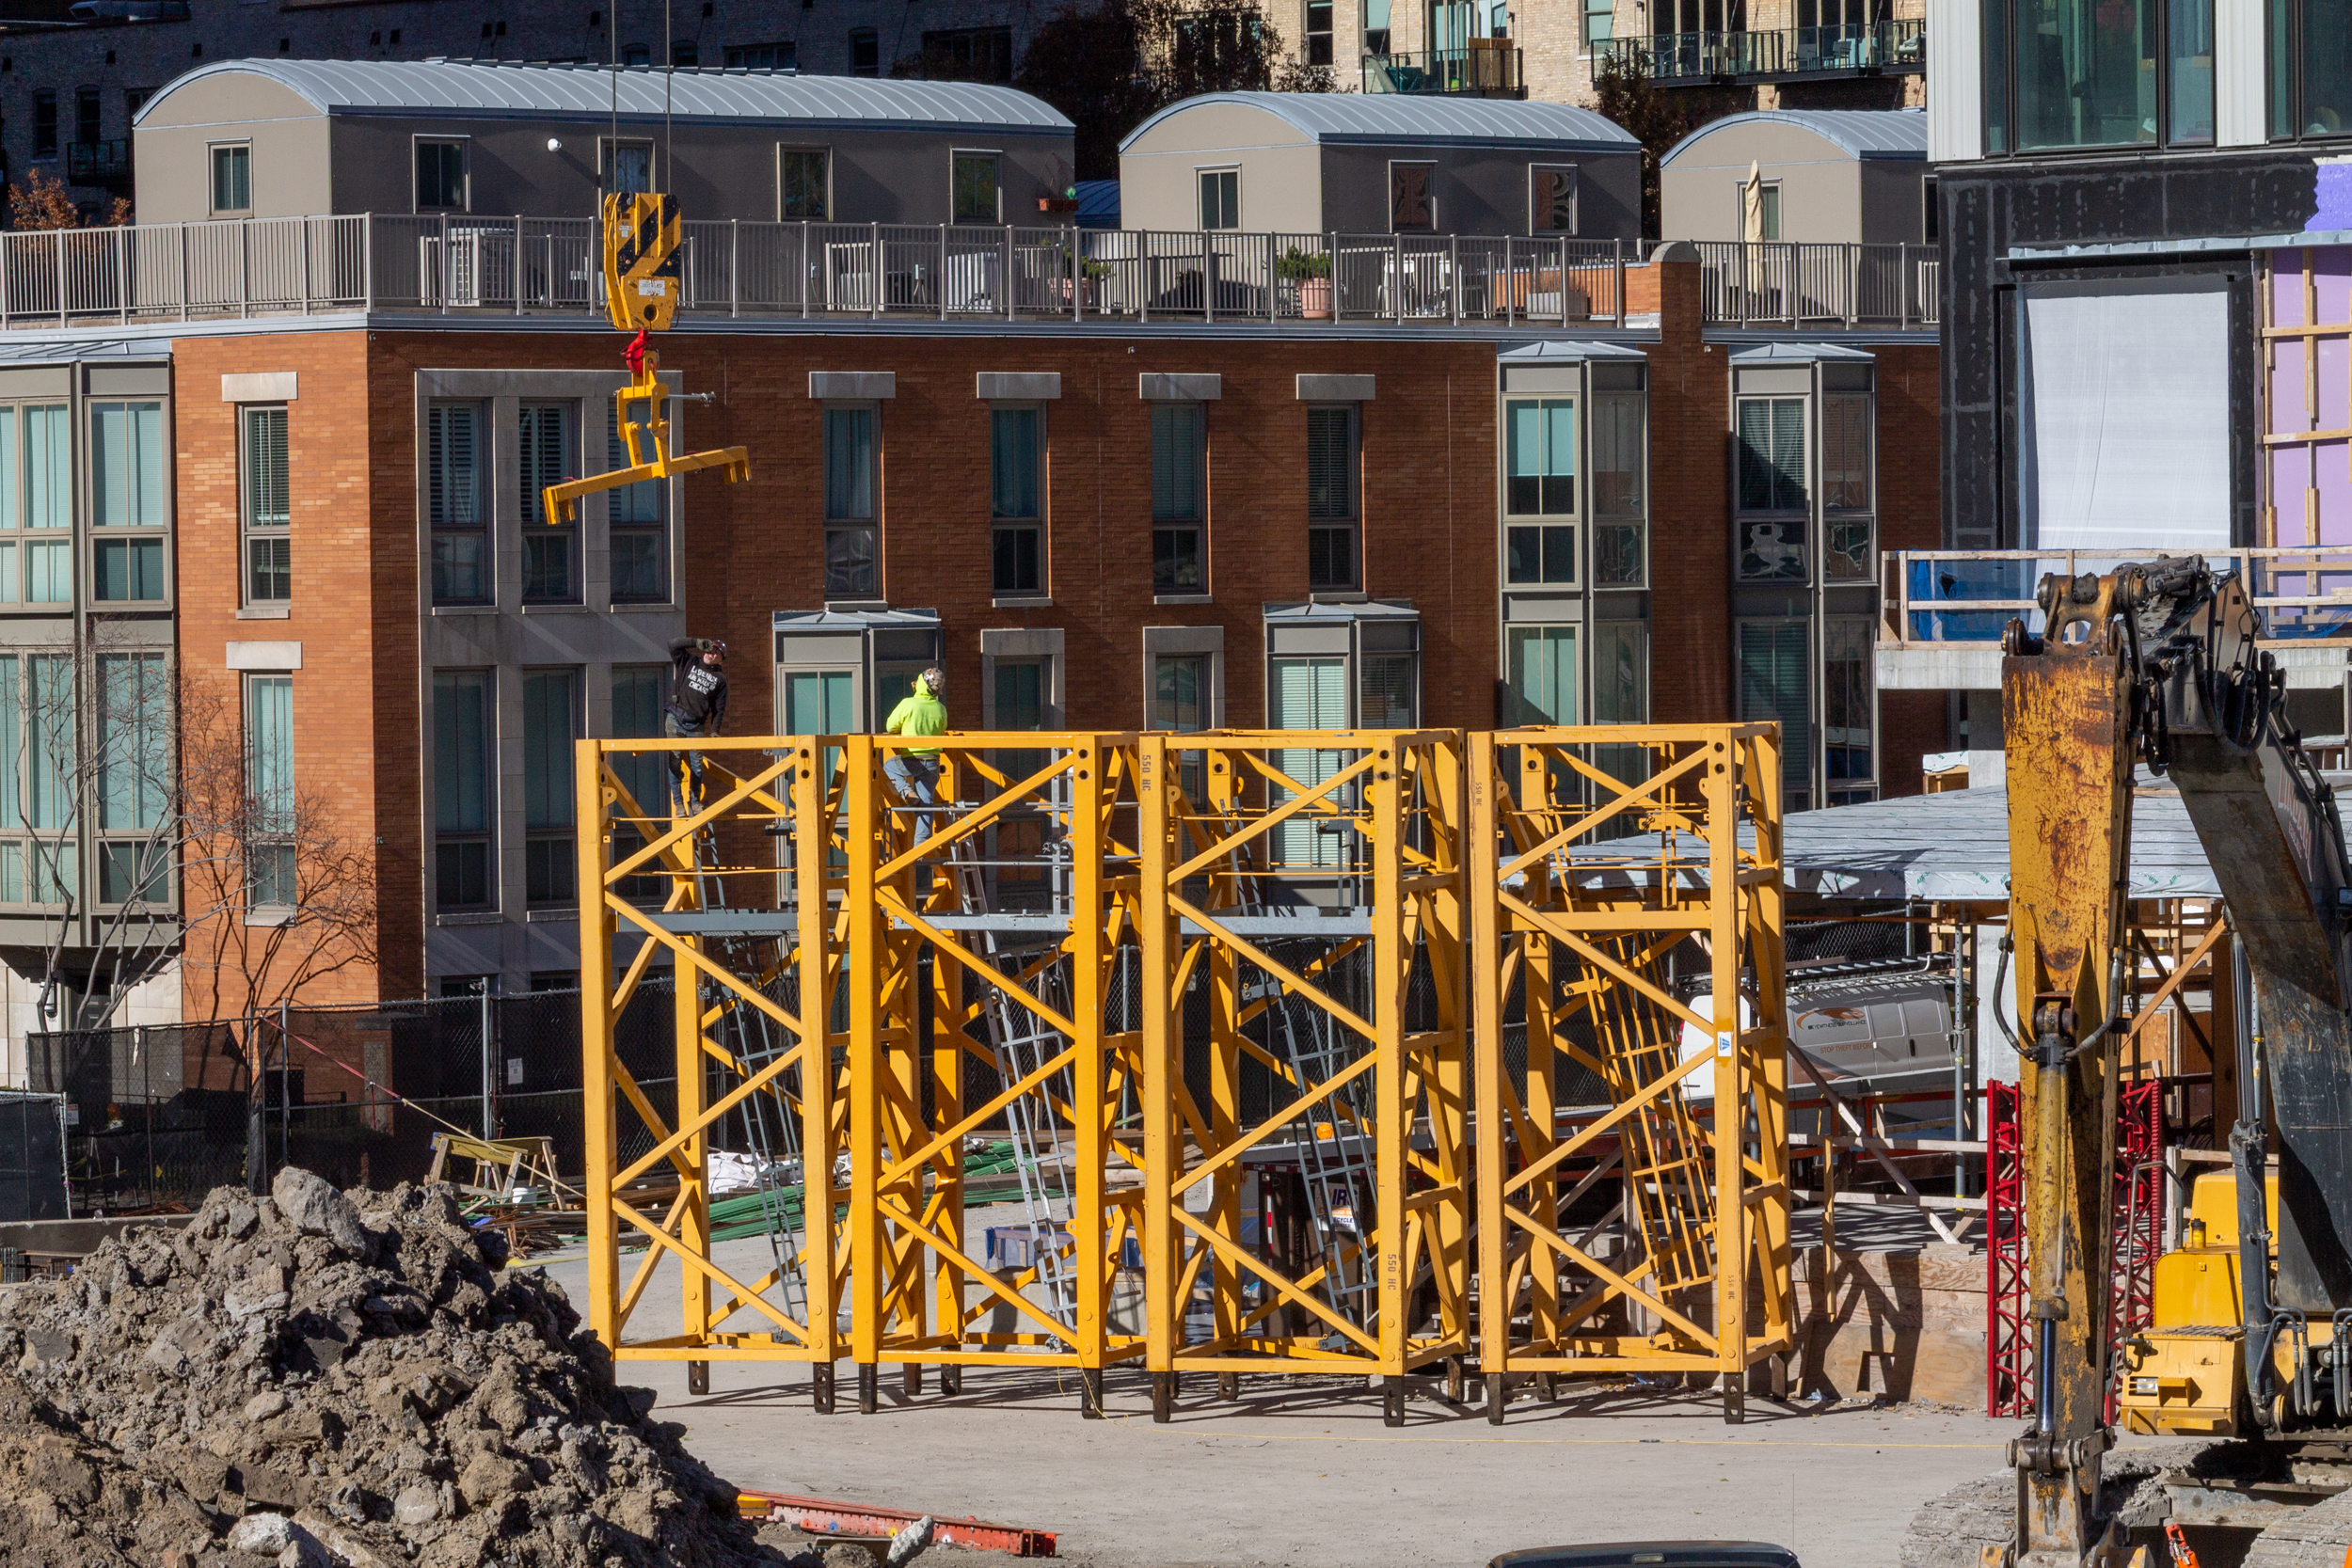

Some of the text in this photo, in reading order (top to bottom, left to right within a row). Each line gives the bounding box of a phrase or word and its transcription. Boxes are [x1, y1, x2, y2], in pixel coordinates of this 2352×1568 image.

[1141, 754, 1152, 791] 550 HC
[1475, 798, 1483, 806] HC
[1836, 1043, 1851, 1052] THEFT
[1852, 1041, 1873, 1051] BEFORE
[1387, 1254, 1397, 1290] 550 HC
[1727, 1291, 1735, 1300] HC
